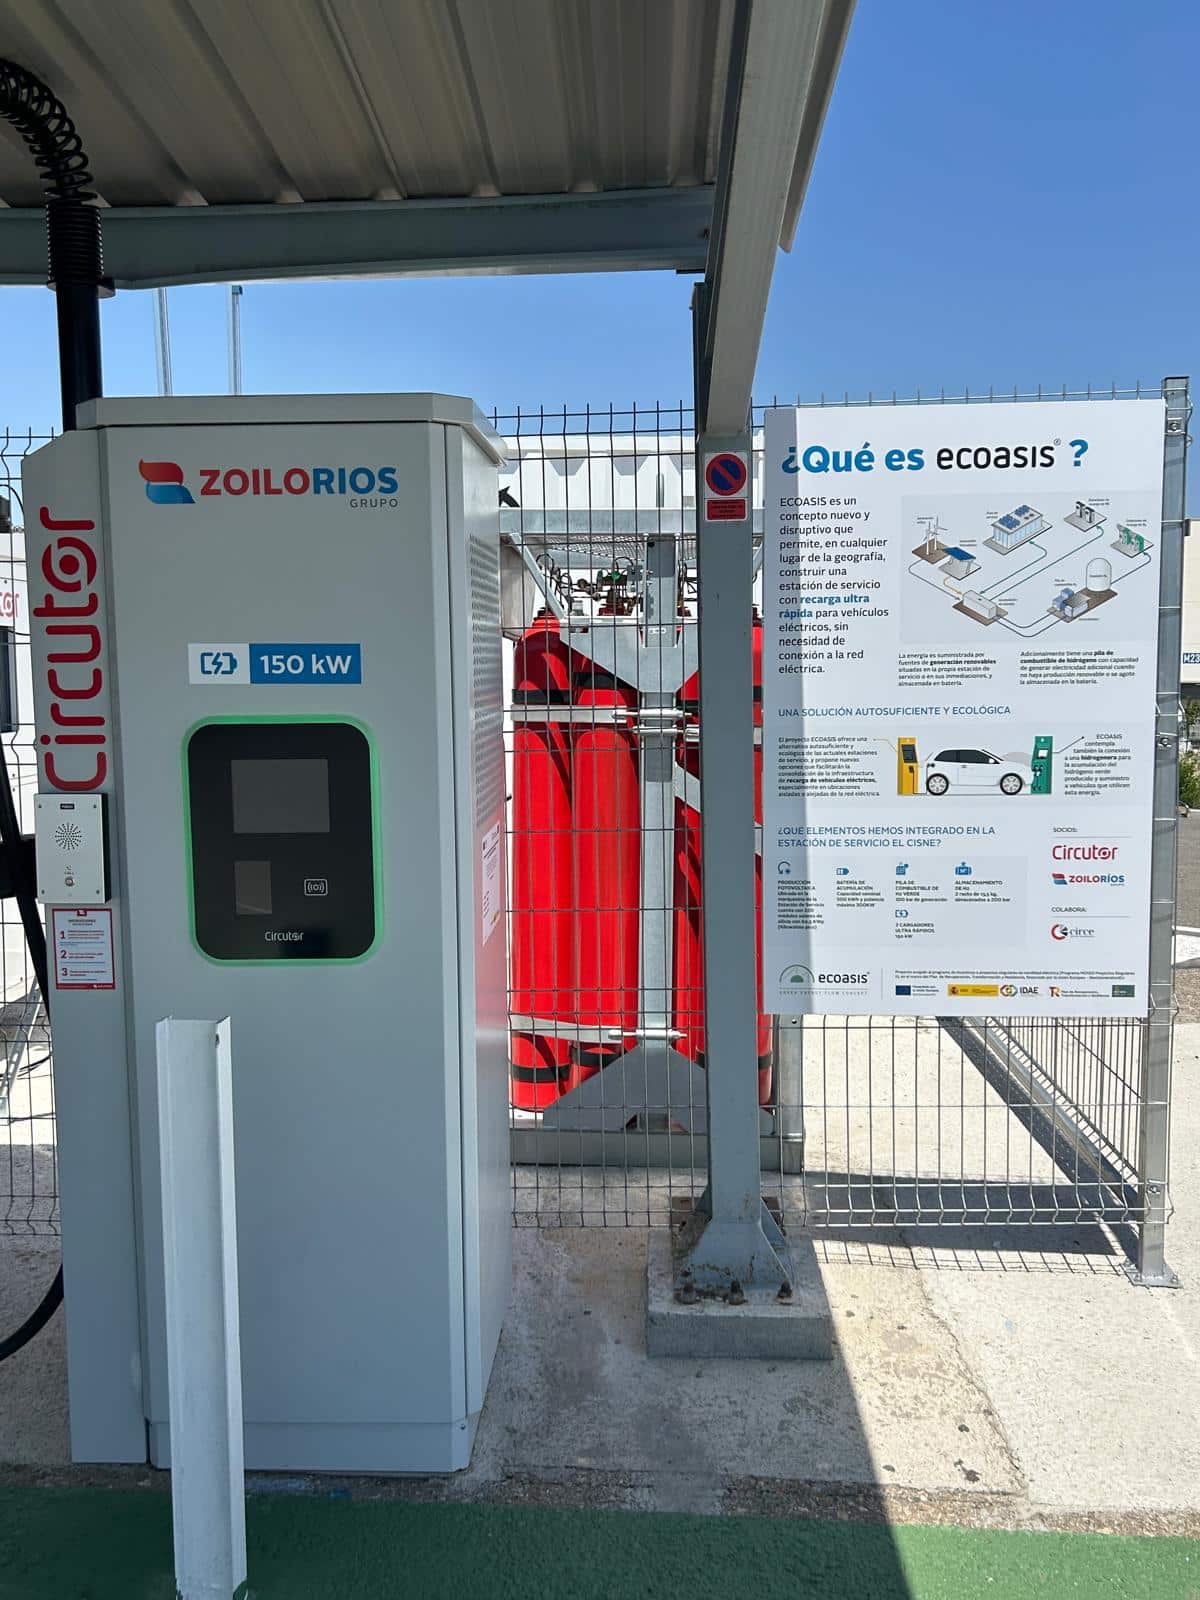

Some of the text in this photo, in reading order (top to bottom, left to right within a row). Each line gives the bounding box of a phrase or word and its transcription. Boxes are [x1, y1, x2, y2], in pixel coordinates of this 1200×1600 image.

[781, 441, 875, 475] ¿Qué
[884, 448, 925, 471] es
[1069, 439, 1089, 467] ?
[200, 467, 399, 496] ZOILORIOS
[350, 499, 399, 508] GRUPO
[779, 496, 857, 507] ECOASIS es un
[780, 510, 871, 523] concepto nuevo y
[779, 525, 854, 537] disruptivo que
[780, 537, 888, 551] permite, en cualquier
[779, 552, 886, 565] lugar de la geografía,
[779, 566, 847, 576] construir una
[779, 579, 881, 590] estación de servicio
[799, 596, 841, 606] recarga
[843, 593, 870, 603] ultra
[778, 607, 889, 620] rápida para vehículos
[778, 621, 849, 633] eléctricos, sin
[778, 635, 846, 646] necesidad de
[778, 650, 824, 660] conexión
[835, 649, 844, 659] la
[846, 649, 864, 659] red
[1093, 649, 1105, 657] pila
[260, 653, 352, 674] 150 kW
[778, 663, 826, 673] eléctrica.
[778, 704, 1011, 717] UNA SOLUCIÓN AUTOSUFICIENTE Y ECOLÓGICA
[806, 826, 866, 835] ELEMENTOS
[868, 826, 904, 835] HEMOS
[905, 826, 964, 835] INTEGRADO
[966, 826, 980, 835] EN
[982, 826, 996, 835] LA
[777, 837, 942, 847] ESTACIÓN DE SERVICIO EL CISNE?
[1052, 844, 1119, 860] Circutor
[264, 931, 305, 942] Circutor
[60, 949, 67, 959] 2
[62, 967, 68, 976] 3
[1019, 986, 1039, 994] IDAE
